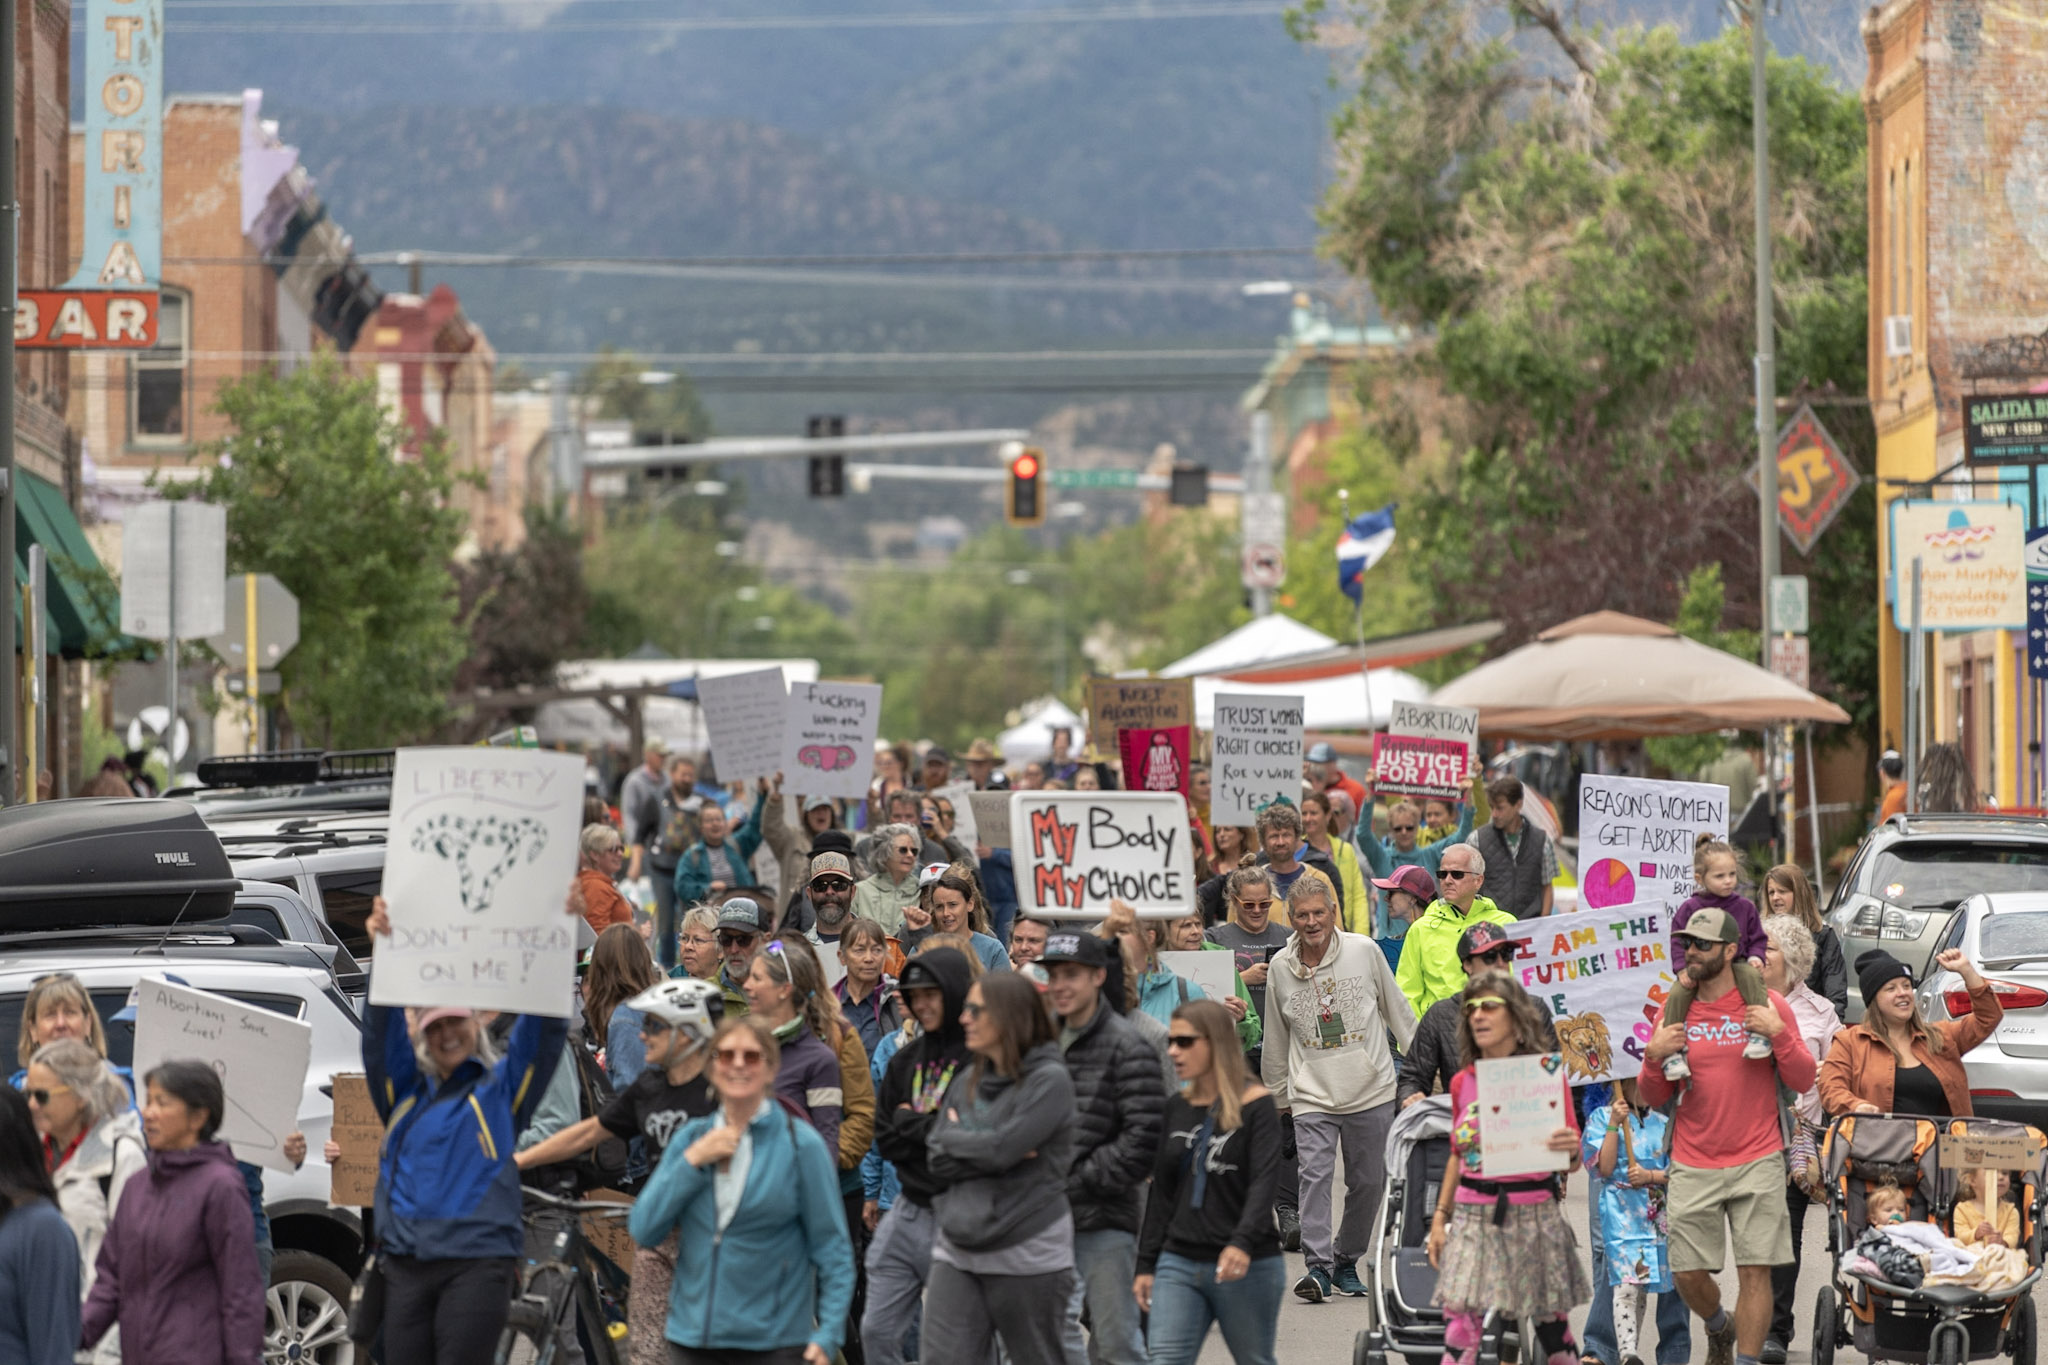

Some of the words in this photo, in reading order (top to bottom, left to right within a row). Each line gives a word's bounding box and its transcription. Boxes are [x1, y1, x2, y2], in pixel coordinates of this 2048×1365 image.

[98, 0, 146, 285] TORIA
[1971, 399, 2034, 426] SALIDA
[1981, 423, 2007, 438] NEW
[1218, 706, 1267, 725] TRUST
[1270, 709, 1304, 726] WOMEN
[1395, 706, 1477, 735] ABORTION
[1150, 745, 1172, 764] MY
[1216, 736, 1250, 755] RIGHT
[1379, 749, 1463, 772] JUSTICE
[1375, 760, 1419, 784] FOR
[1424, 768, 1462, 787] ALL
[1583, 786, 1653, 819] REASONS
[1658, 794, 1723, 823] WOMEN
[1089, 806, 1176, 867] Body
[1598, 823, 1637, 847] GET
[154, 851, 190, 864] THULE
[1660, 863, 1694, 880] NONE
[1087, 866, 1183, 902] CHOICE
[1551, 926, 1598, 957] AM
[1609, 915, 1659, 941] THE
[419, 960, 456, 984] ON
[1521, 953, 1608, 988] FUTURE!
[1615, 942, 1667, 971] HEAR
[1486, 1060, 1538, 1083] Girls
